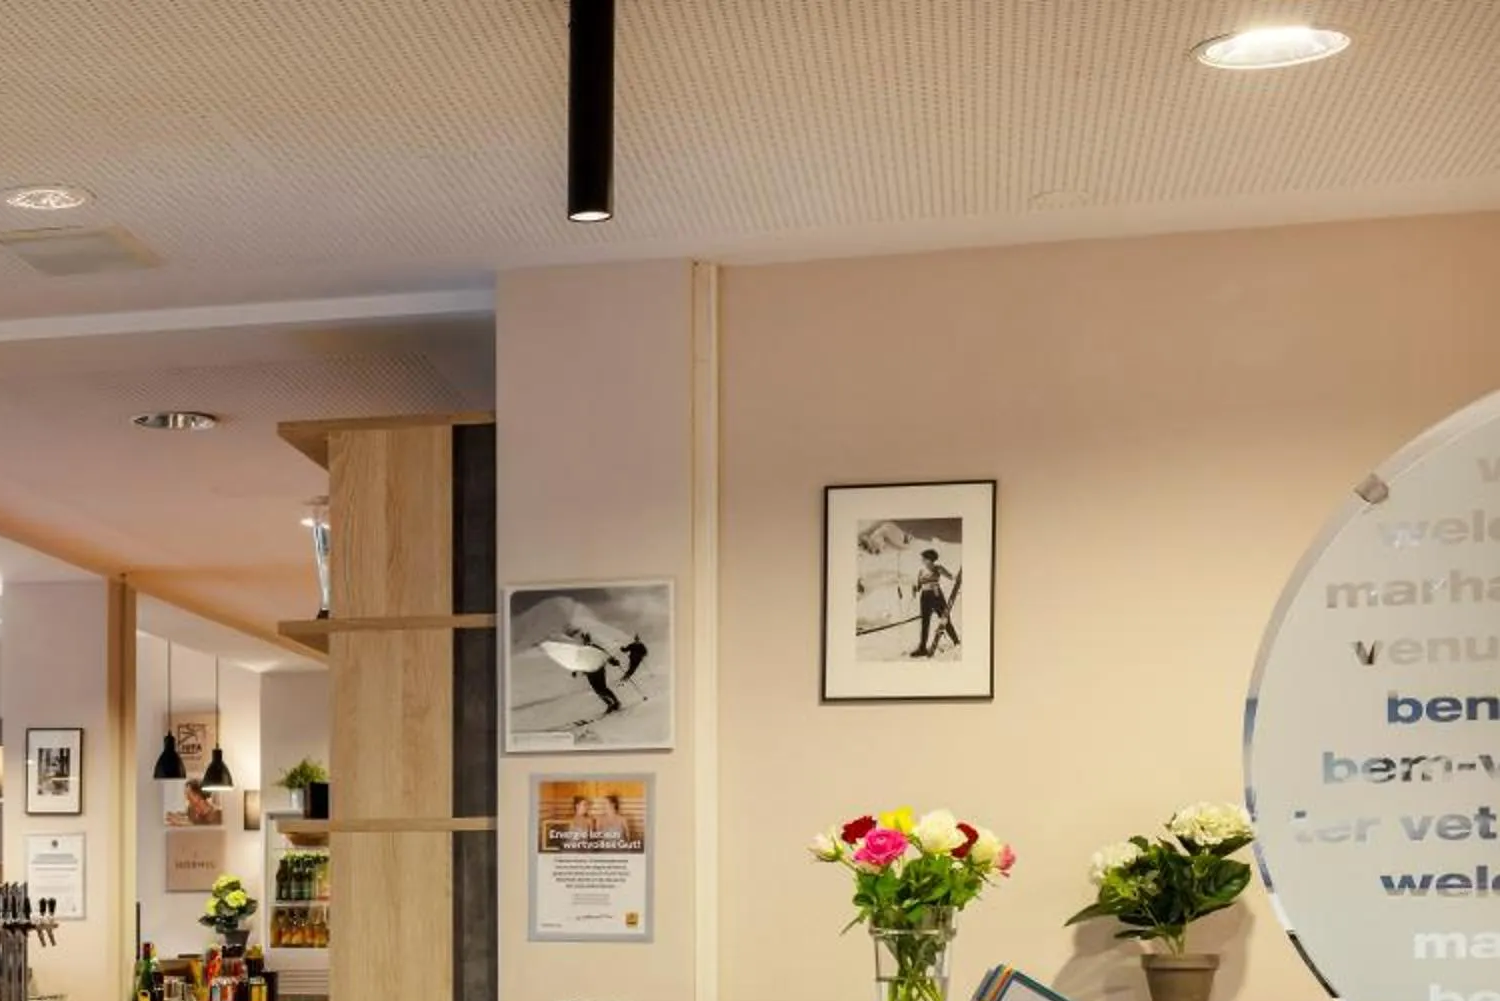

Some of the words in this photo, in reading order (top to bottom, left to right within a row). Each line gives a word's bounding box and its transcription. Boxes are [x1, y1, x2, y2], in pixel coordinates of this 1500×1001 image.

[1350, 636, 1500, 666] venu
[1387, 690, 1500, 724] ben
[549, 829, 588, 841] Energie
[1379, 865, 1500, 898] wel
[1413, 931, 1500, 960] ma
